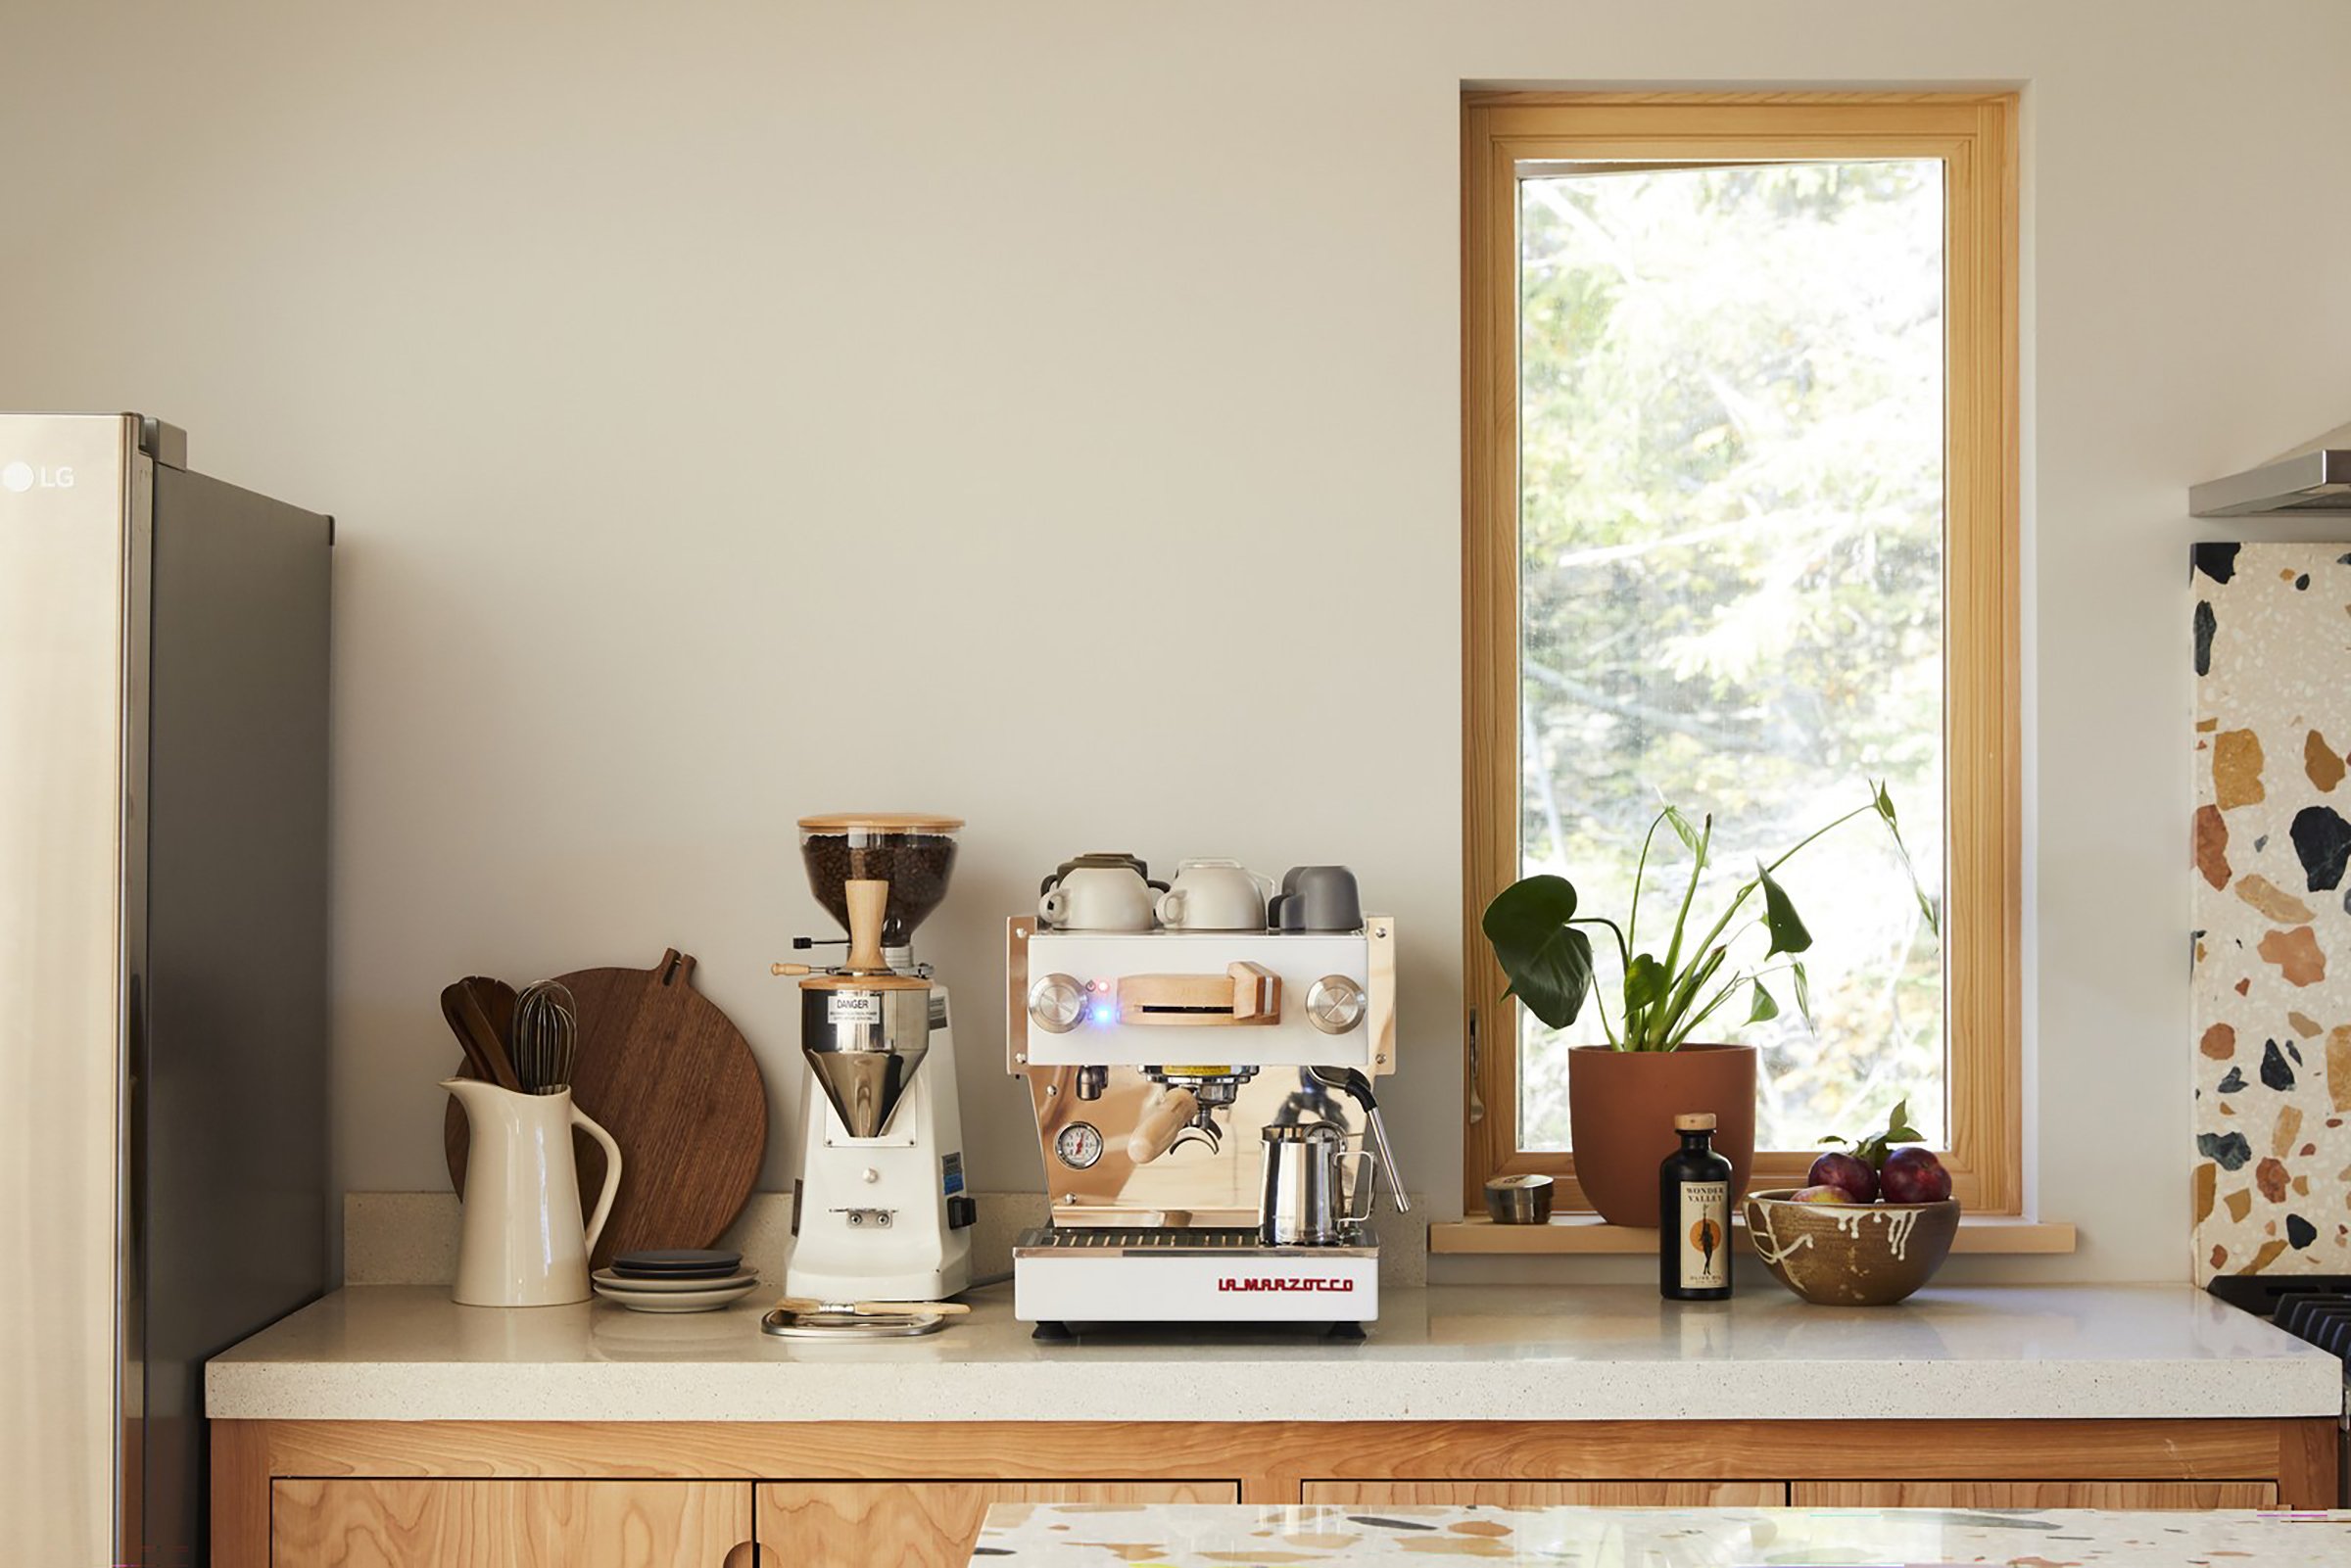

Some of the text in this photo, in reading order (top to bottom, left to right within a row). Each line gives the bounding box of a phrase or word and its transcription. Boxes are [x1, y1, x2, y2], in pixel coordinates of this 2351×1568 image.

[40, 465, 74, 488] LG
[837, 999, 869, 1009] DANGER
[1219, 1278, 1354, 1292] LA MARZOCCO
